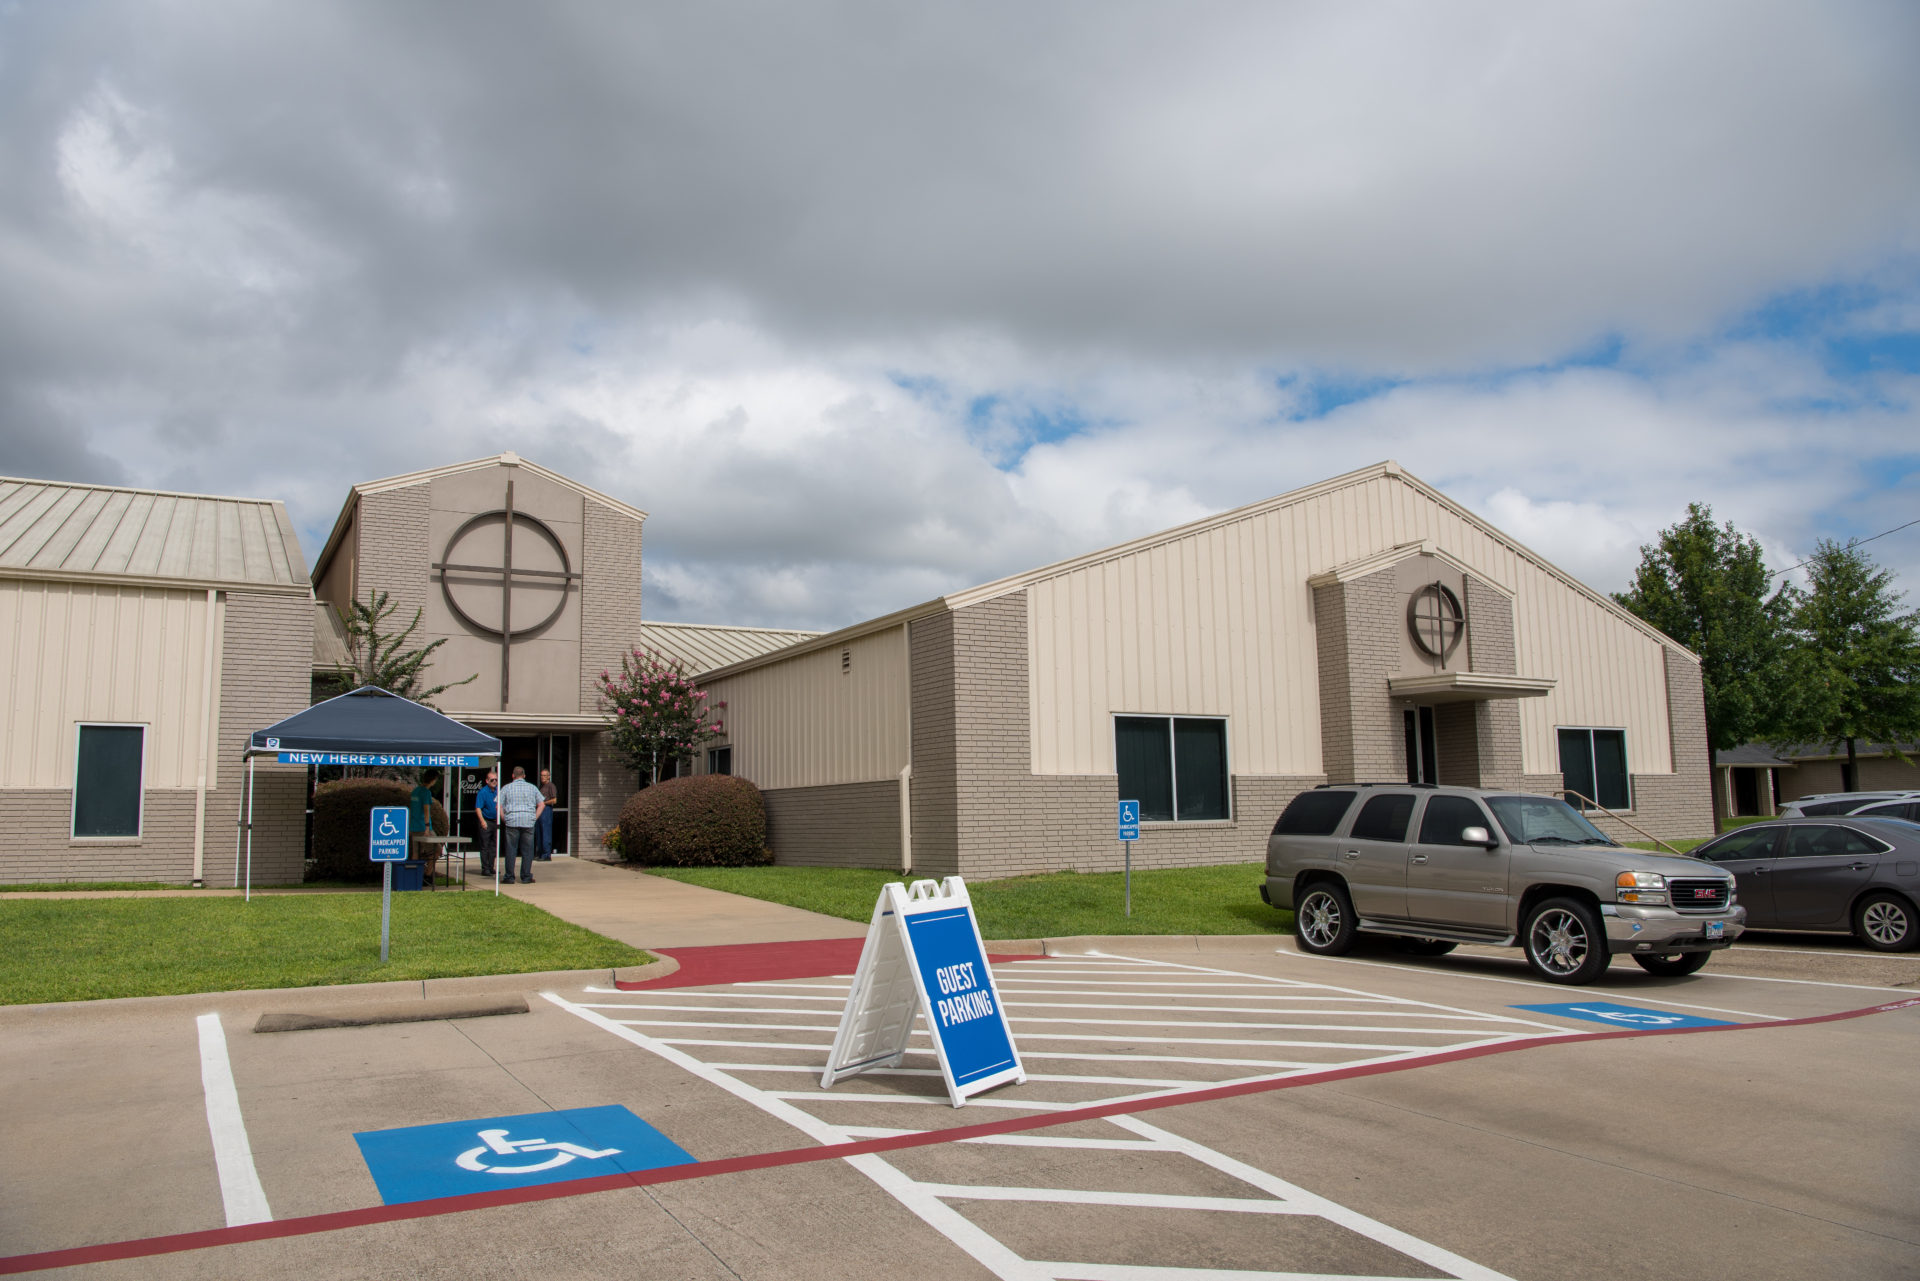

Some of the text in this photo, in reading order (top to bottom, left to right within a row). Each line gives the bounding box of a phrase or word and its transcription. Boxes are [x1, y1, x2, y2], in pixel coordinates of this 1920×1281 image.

[289, 752, 469, 766] NEW HERE? START HERE.
[461, 780, 482, 790] Rush
[1694, 888, 1716, 899] GMC
[936, 961, 978, 995] GUEST
[937, 989, 994, 1028] PARKING
